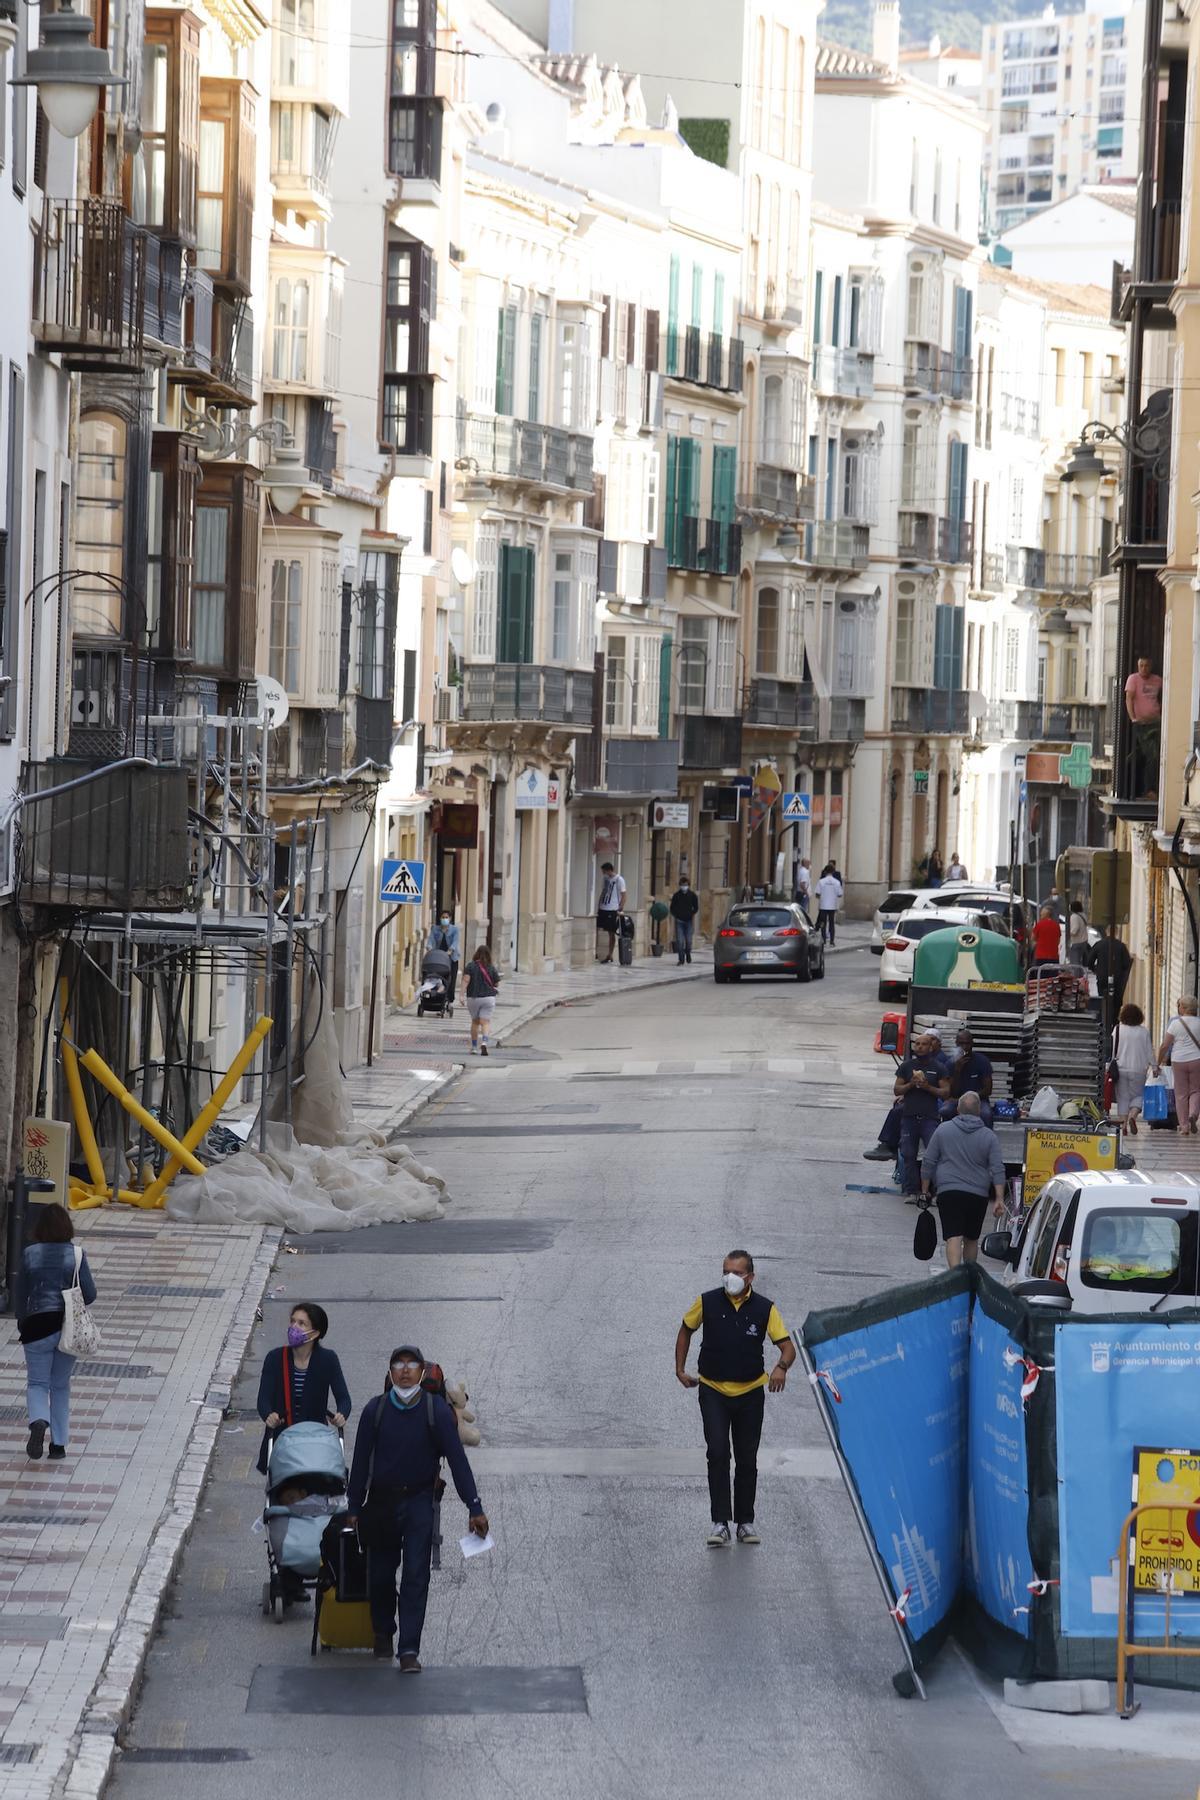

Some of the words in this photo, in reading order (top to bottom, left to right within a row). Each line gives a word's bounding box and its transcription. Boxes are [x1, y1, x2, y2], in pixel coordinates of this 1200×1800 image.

[1030, 1132, 1062, 1141] POLICIA
[1065, 1135, 1091, 1143] LOCAL
[1040, 1140, 1075, 1150] MALAGA
[1114, 1342, 1191, 1352] Ayuntamiento
[1113, 1357, 1149, 1366] Gerencia
[1151, 1356, 1193, 1367] Municipal
[1139, 1556, 1193, 1571] PROHIBIDO
[1138, 1572, 1157, 1586] LAS
